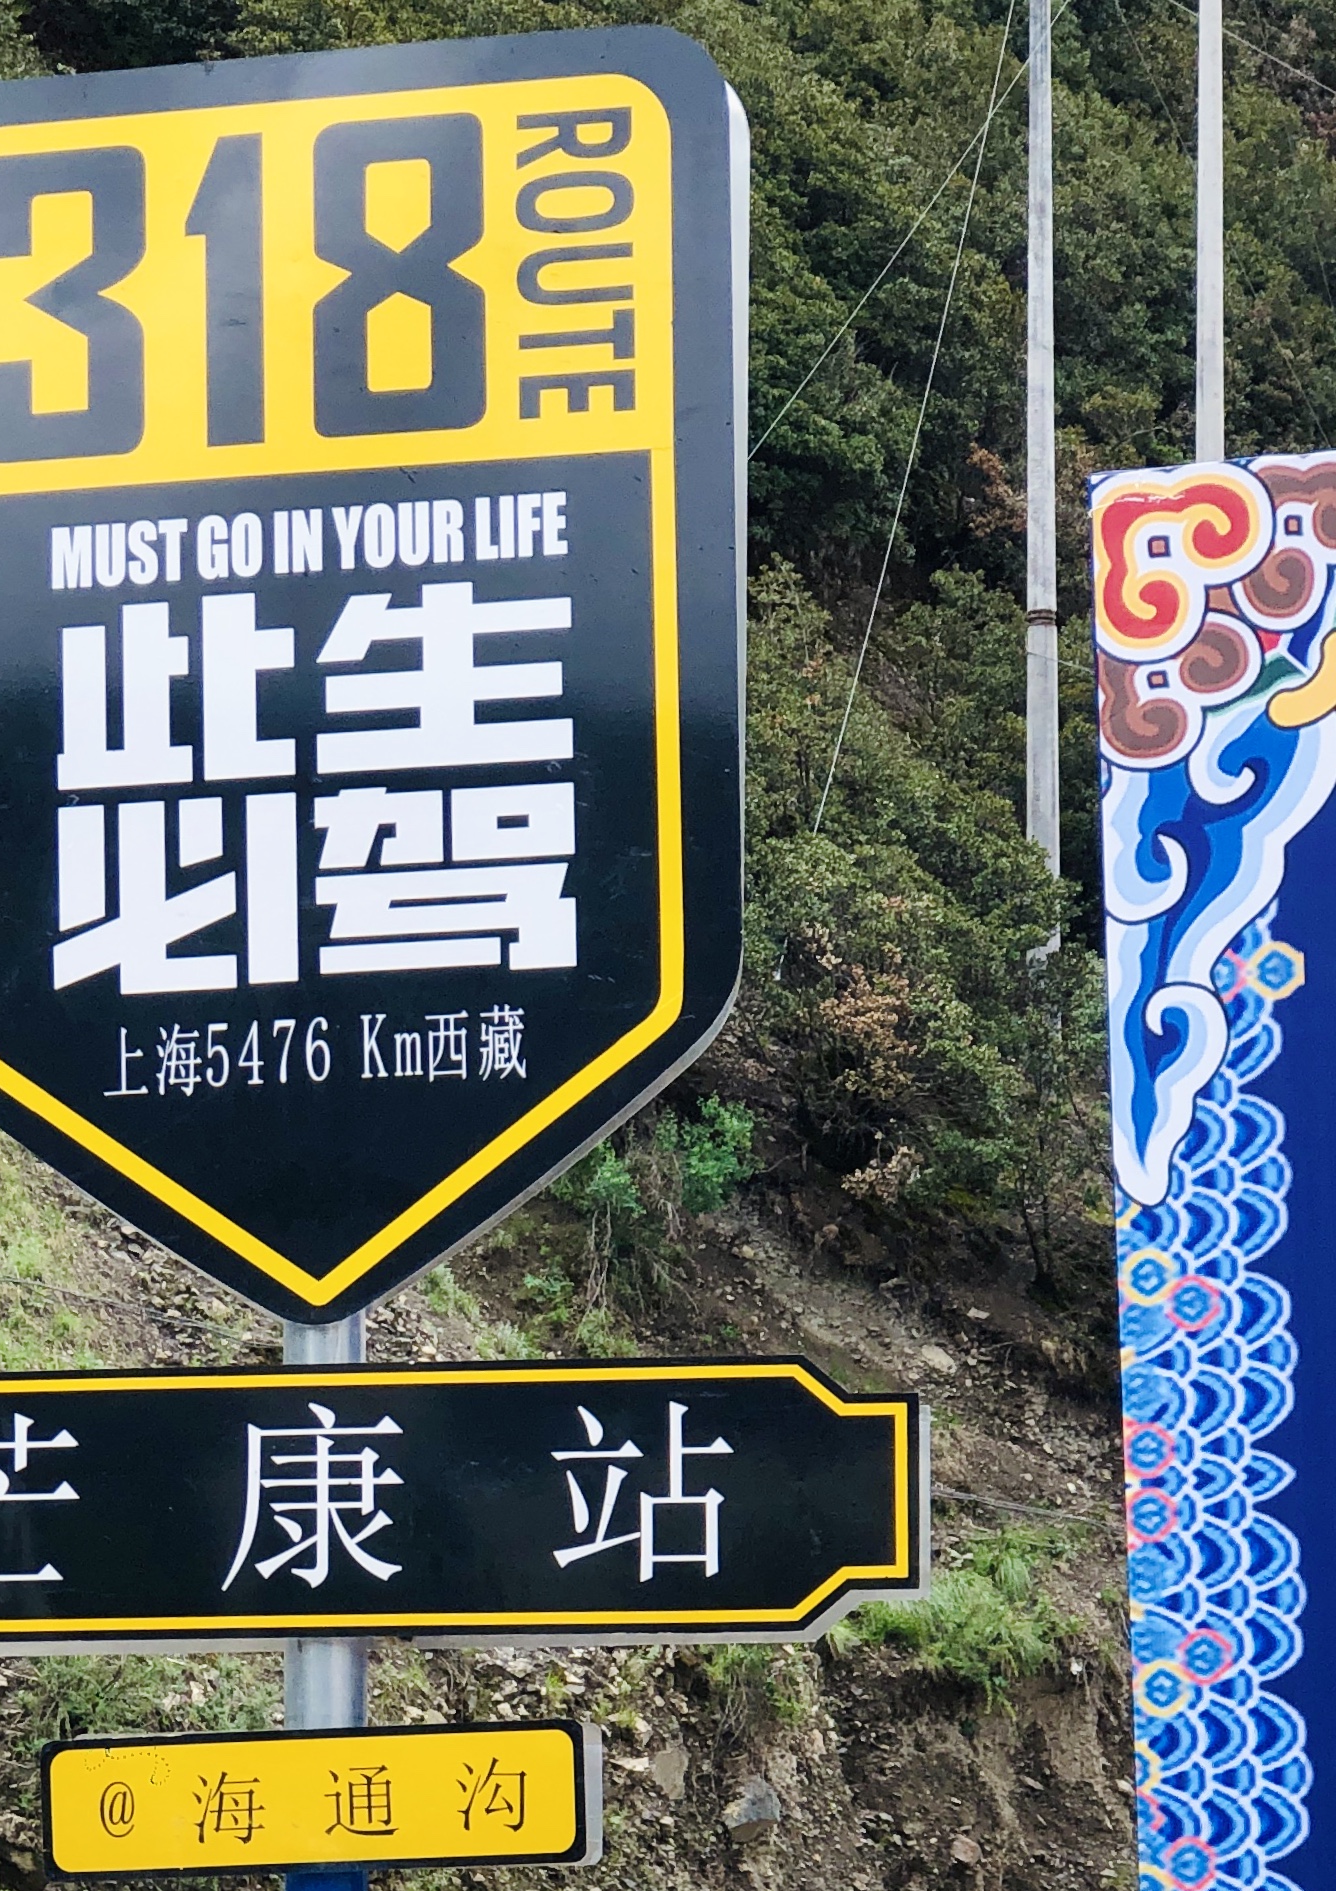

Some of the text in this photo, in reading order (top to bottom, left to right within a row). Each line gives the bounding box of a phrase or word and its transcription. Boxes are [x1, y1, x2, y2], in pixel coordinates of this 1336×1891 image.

[515, 105, 638, 421] ROUTE
[51, 491, 568, 590] MUST GO IN YOUR LIFE
[55, 581, 575, 792] 此生
[53, 782, 578, 996] 必驾
[103, 1014, 332, 1098] 上海5476
